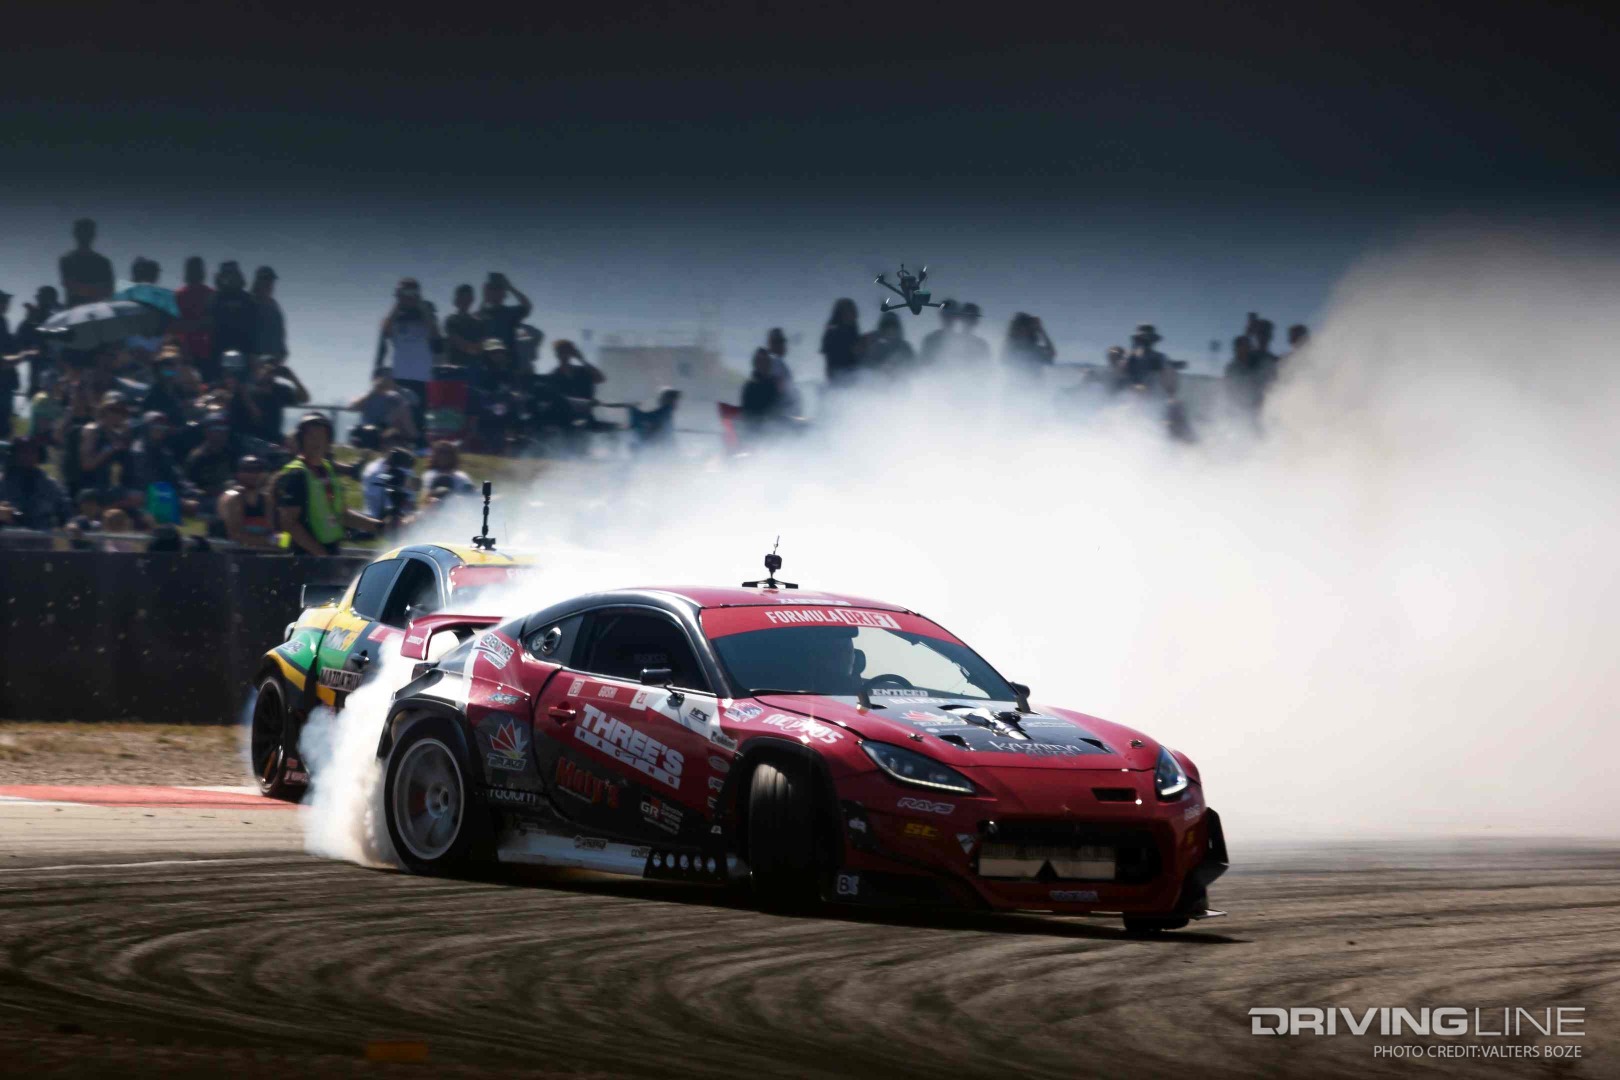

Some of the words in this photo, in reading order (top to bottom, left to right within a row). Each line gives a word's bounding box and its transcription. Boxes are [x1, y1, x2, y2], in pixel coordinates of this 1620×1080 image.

[872, 688, 928, 697] ENTICED
[583, 703, 684, 777] THREE'S
[640, 801, 659, 818] GR
